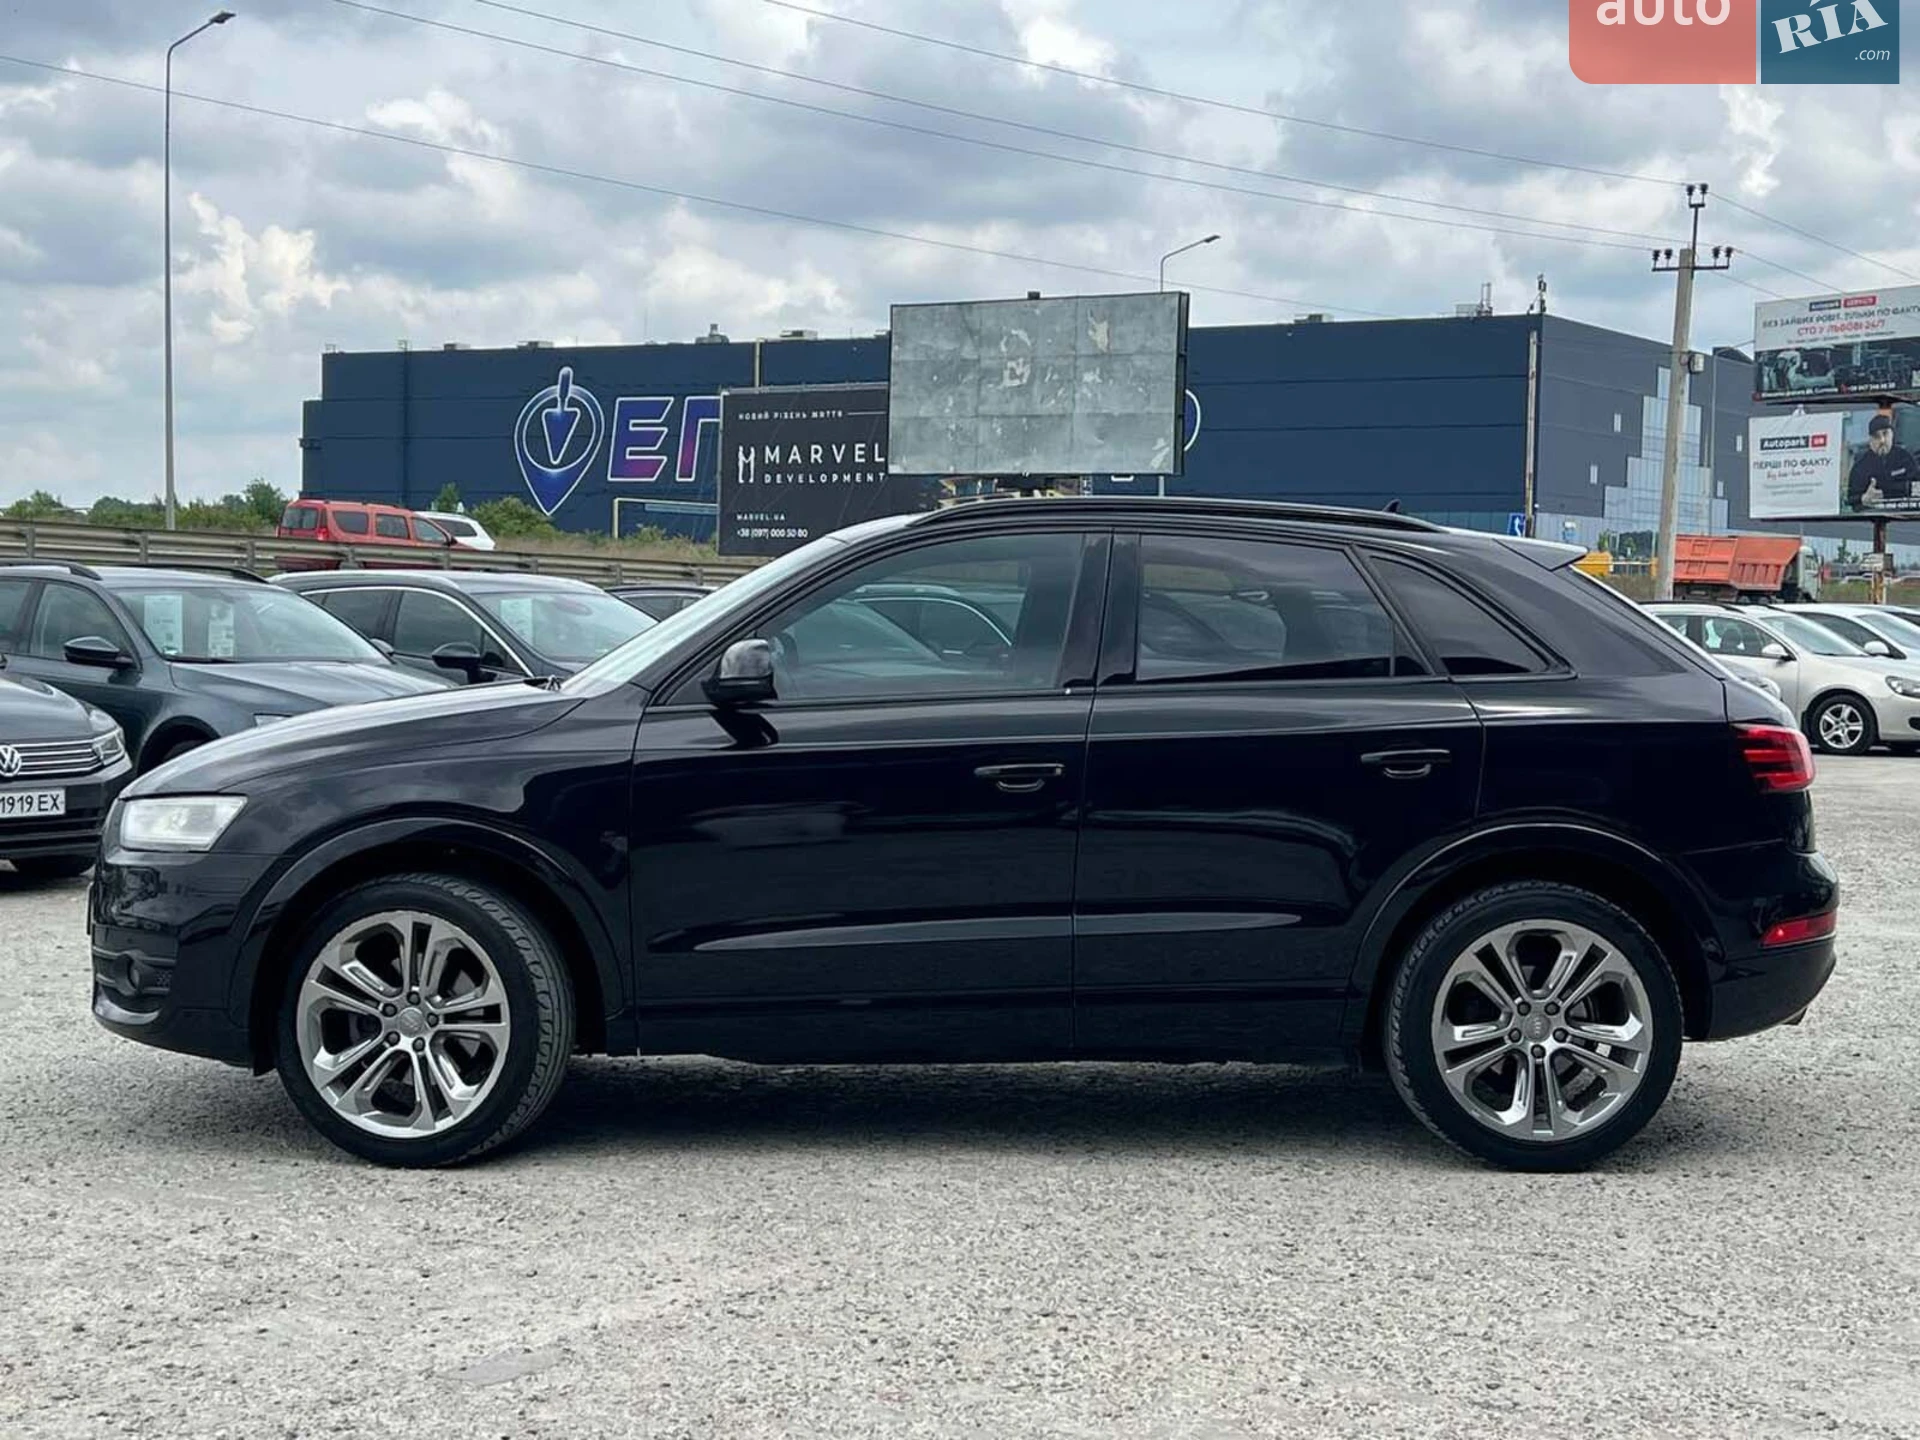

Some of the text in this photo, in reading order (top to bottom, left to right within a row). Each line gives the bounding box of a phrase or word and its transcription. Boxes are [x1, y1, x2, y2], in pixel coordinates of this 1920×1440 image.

[1762, 438, 1807, 449] Autopark
[764, 443, 885, 464] MARVEL
[1783, 459, 1798, 468] ПО
[764, 472, 887, 484] DEVELOPMENT
[38, 794, 60, 812] EX
